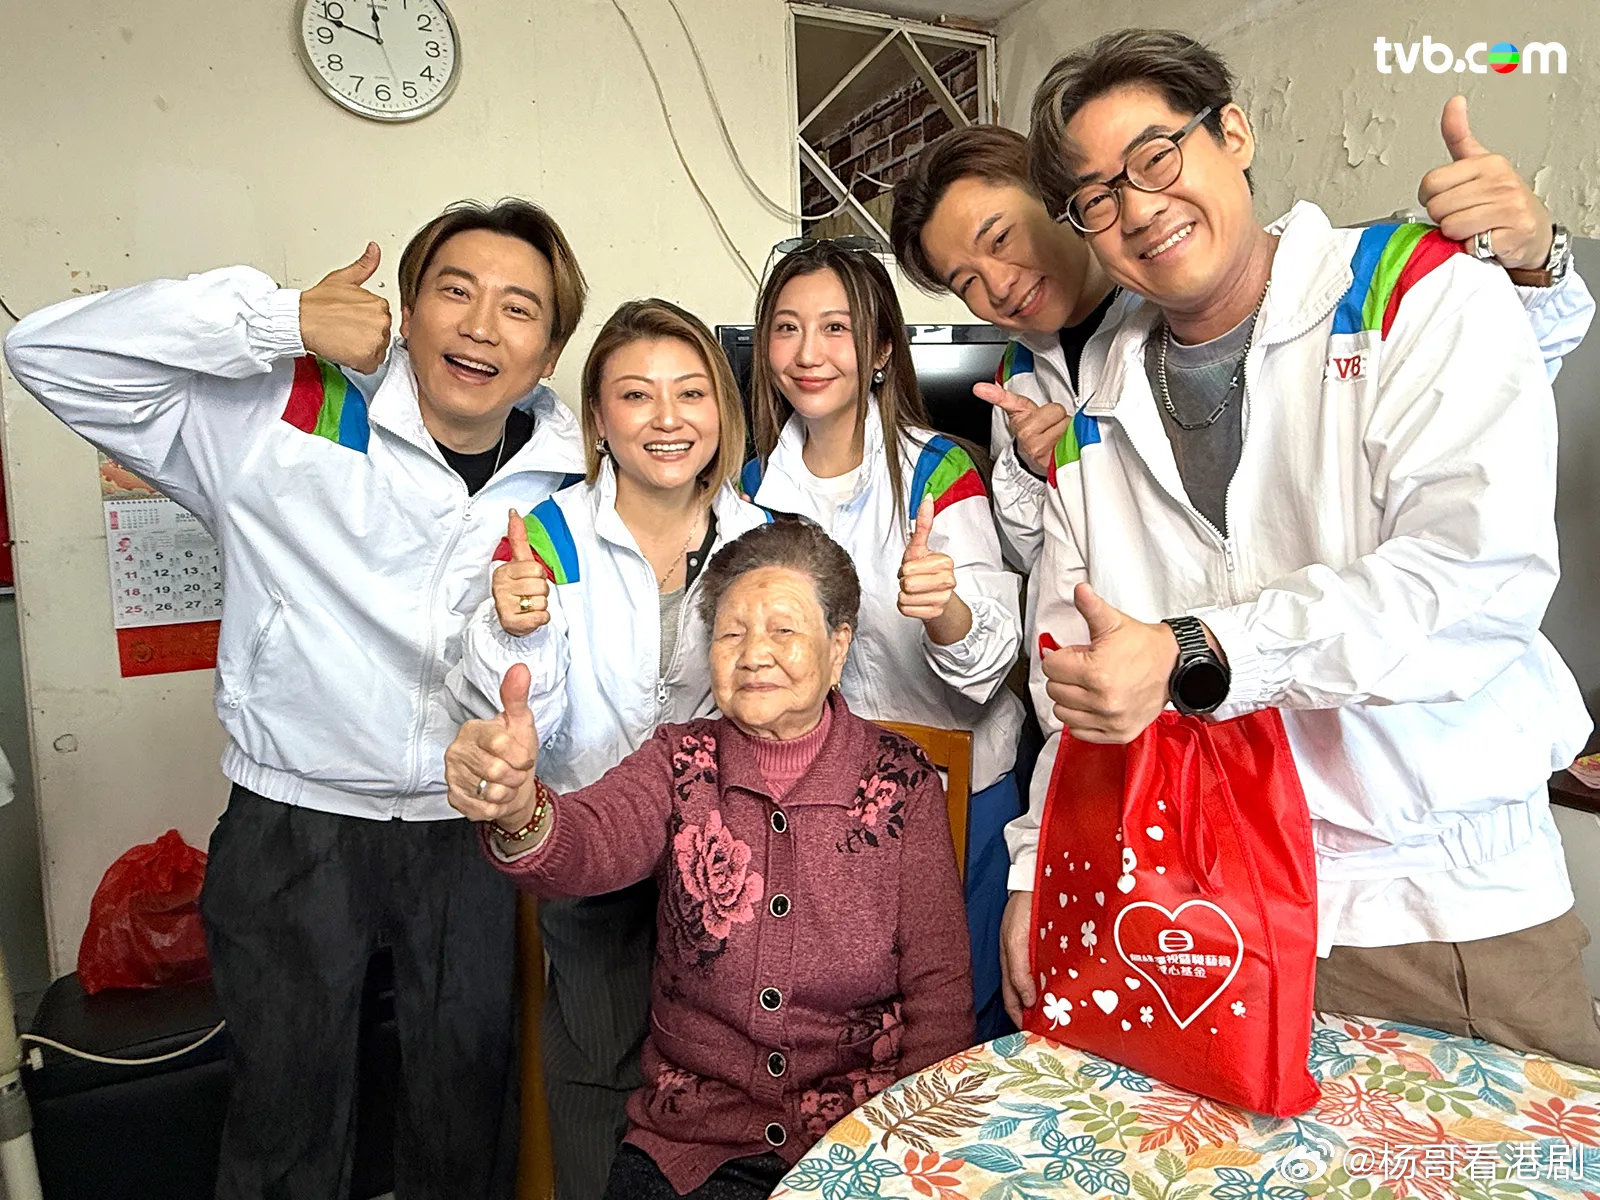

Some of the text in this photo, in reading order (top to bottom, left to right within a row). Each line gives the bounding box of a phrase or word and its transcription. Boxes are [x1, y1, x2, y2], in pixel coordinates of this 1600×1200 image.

[320, 1, 344, 20] 10
[417, 14, 432, 32] 2
[316, 26, 334, 44] 9
[425, 41, 441, 58] 3
[327, 54, 344, 71] 8
[419, 65, 435, 82] 4
[349, 75, 364, 93] 7
[375, 84, 391, 101] 6
[402, 81, 417, 99] 5
[1323, 355, 1361, 379] VB
[125, 554, 134, 562] 4
[155, 552, 164, 560] 5
[185, 550, 194, 558] 6
[124, 571, 138, 579] 11
[152, 569, 169, 577] 12
[182, 567, 199, 575] 13
[124, 588, 141, 597] 18
[154, 586, 170, 594] 19
[183, 583, 201, 592] 20
[124, 605, 143, 614] 25
[155, 603, 173, 611] 26
[184, 600, 202, 609] 27
